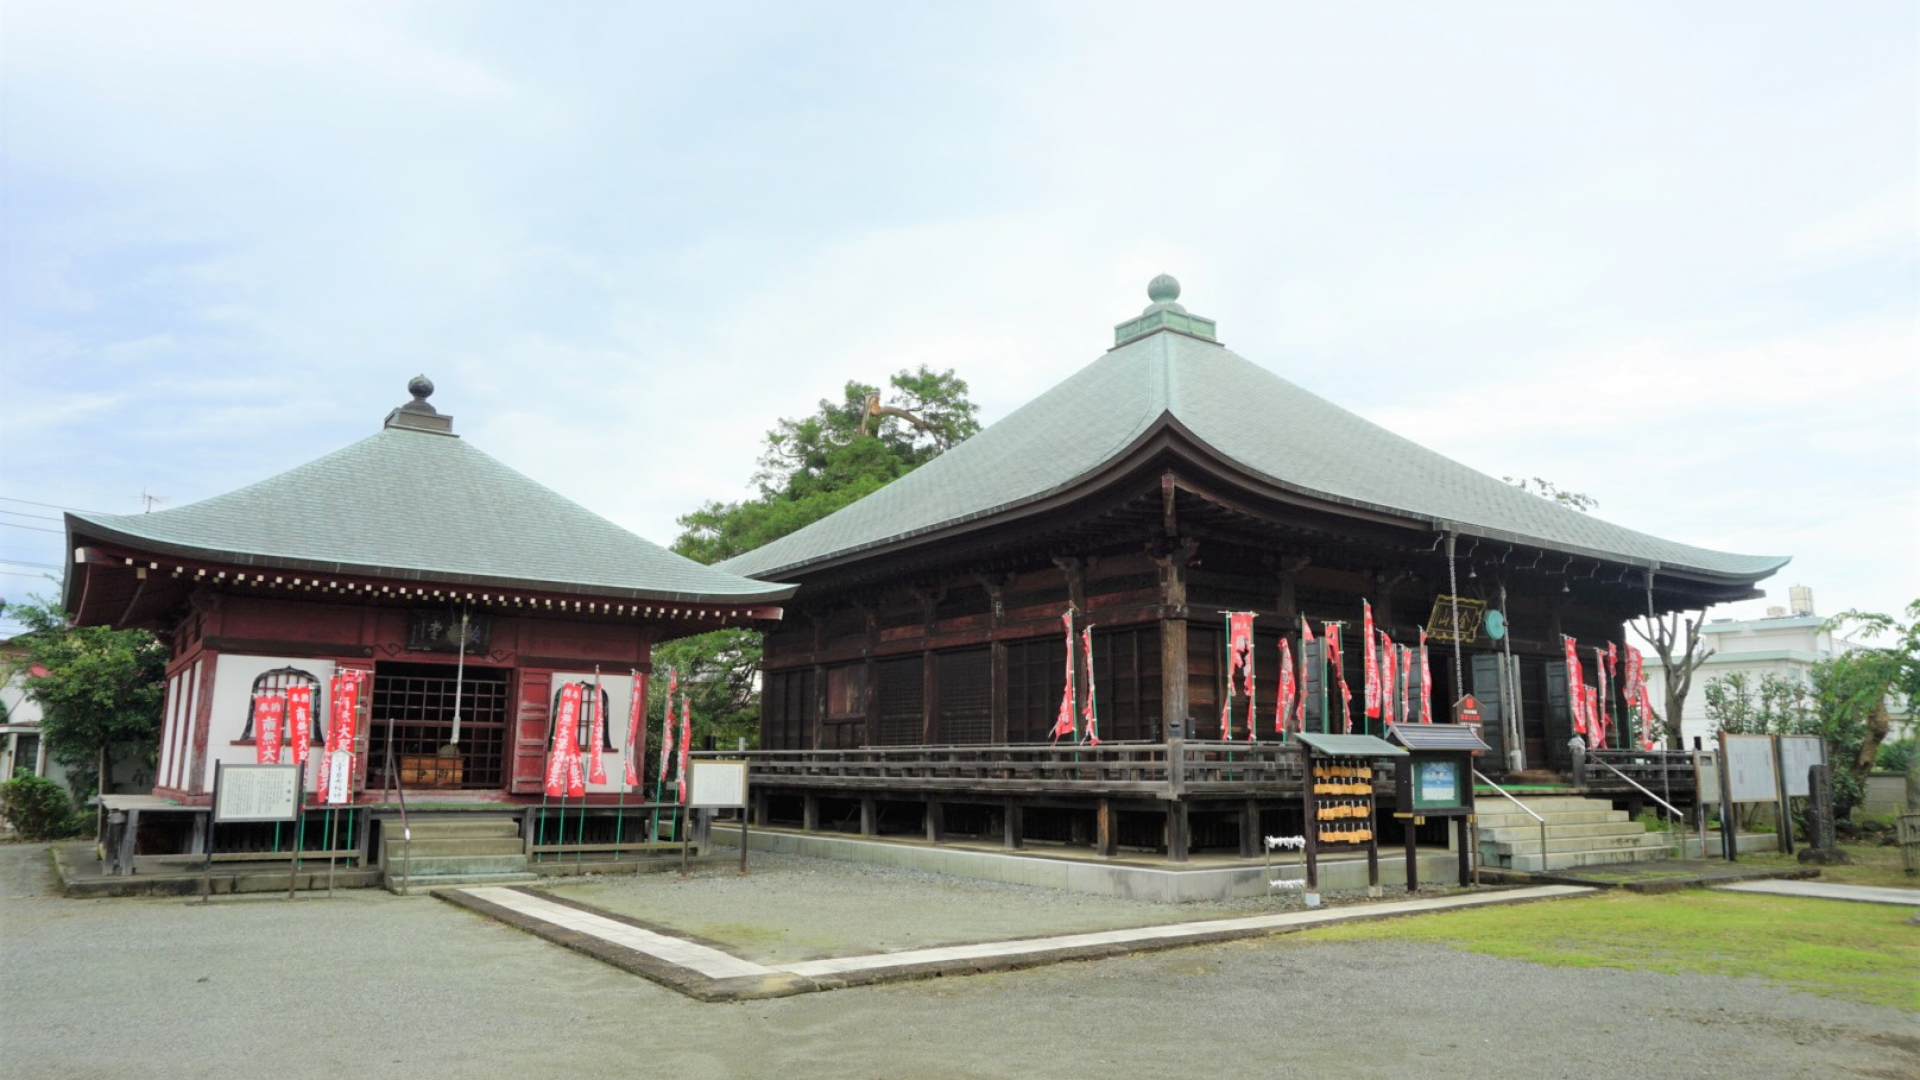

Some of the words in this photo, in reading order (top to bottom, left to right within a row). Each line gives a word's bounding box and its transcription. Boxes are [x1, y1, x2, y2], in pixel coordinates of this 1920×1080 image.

[292, 693, 309, 703] 奉納
[259, 702, 281, 713] 奉納
[261, 716, 277, 764] 南無大
